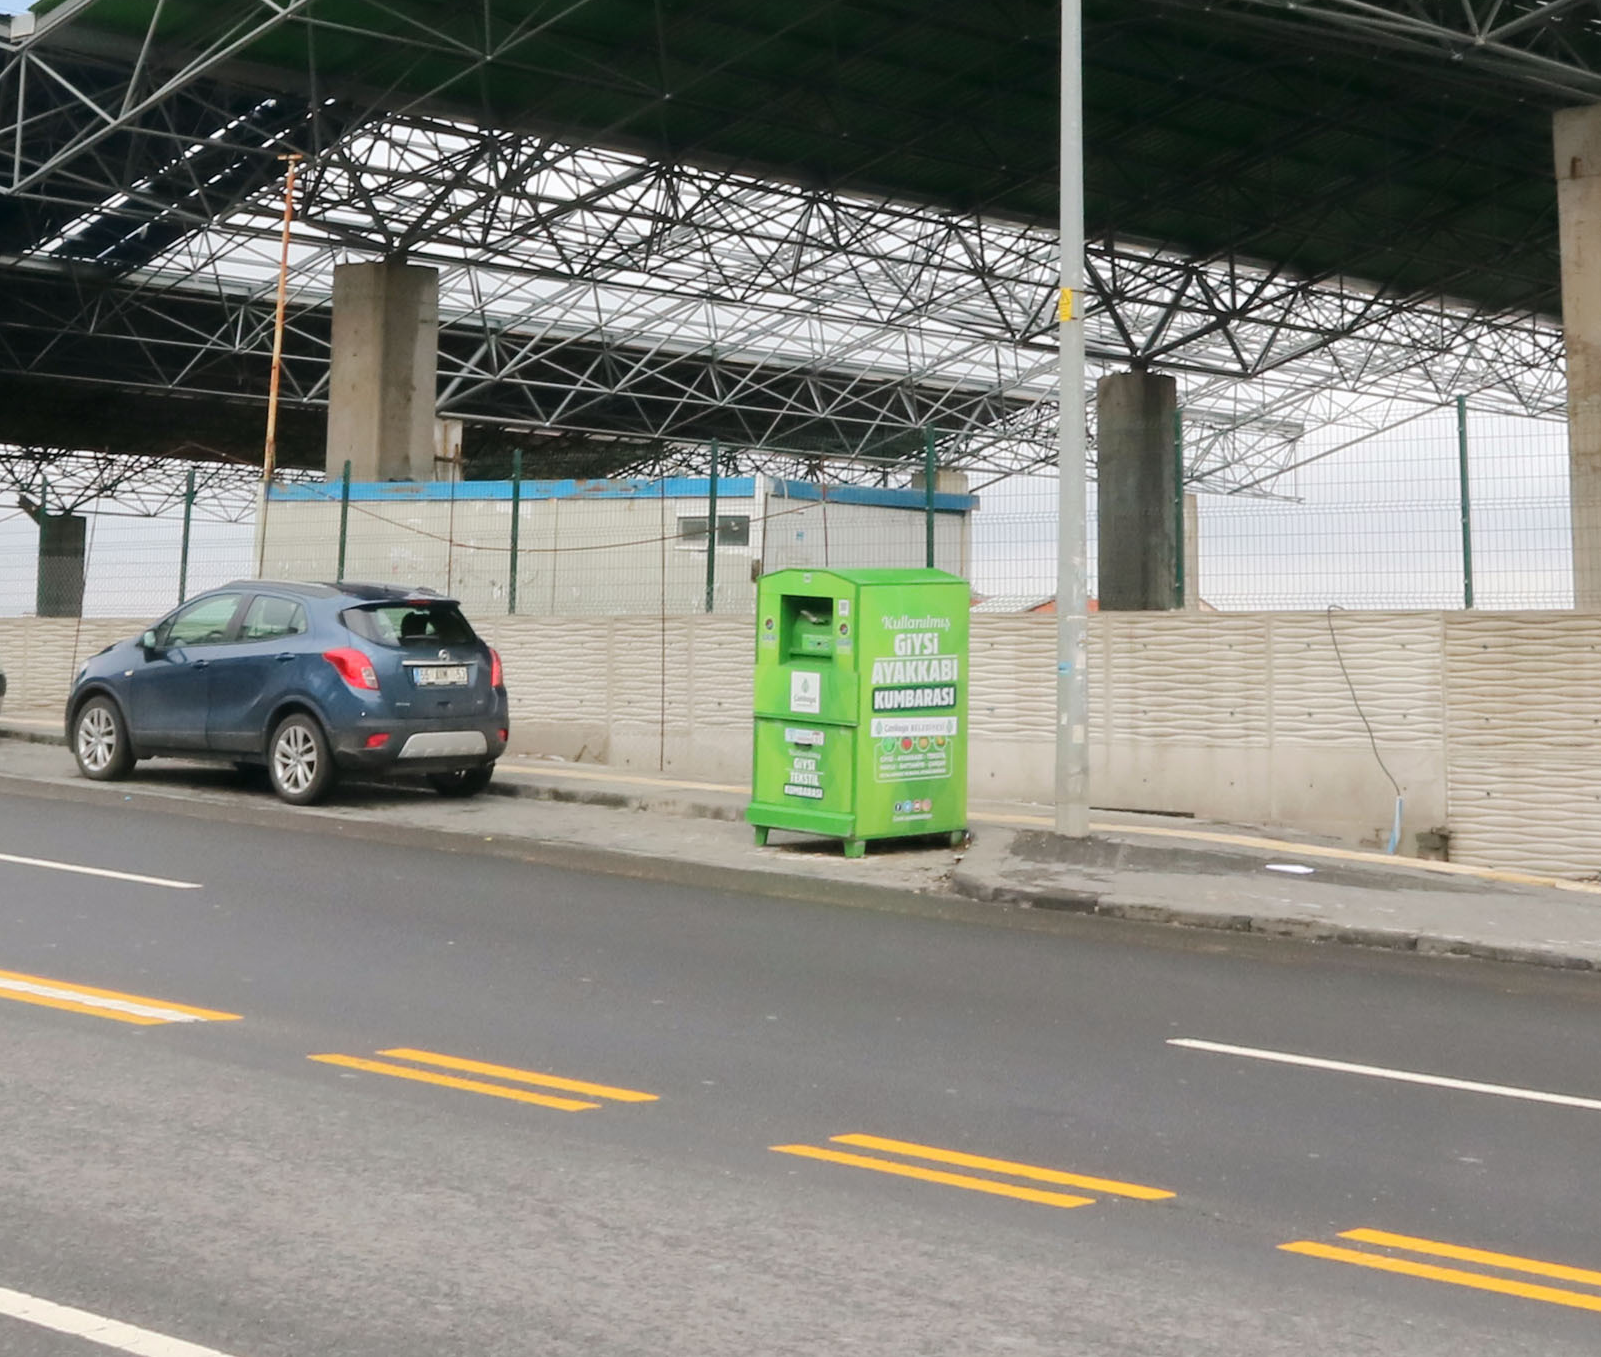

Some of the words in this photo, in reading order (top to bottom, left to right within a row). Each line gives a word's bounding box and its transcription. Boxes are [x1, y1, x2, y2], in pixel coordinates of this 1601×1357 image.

[881, 614, 951, 632] Kullanılmış
[872, 659, 958, 684] AYAKKABI
[874, 688, 954, 710] KUMBARASI
